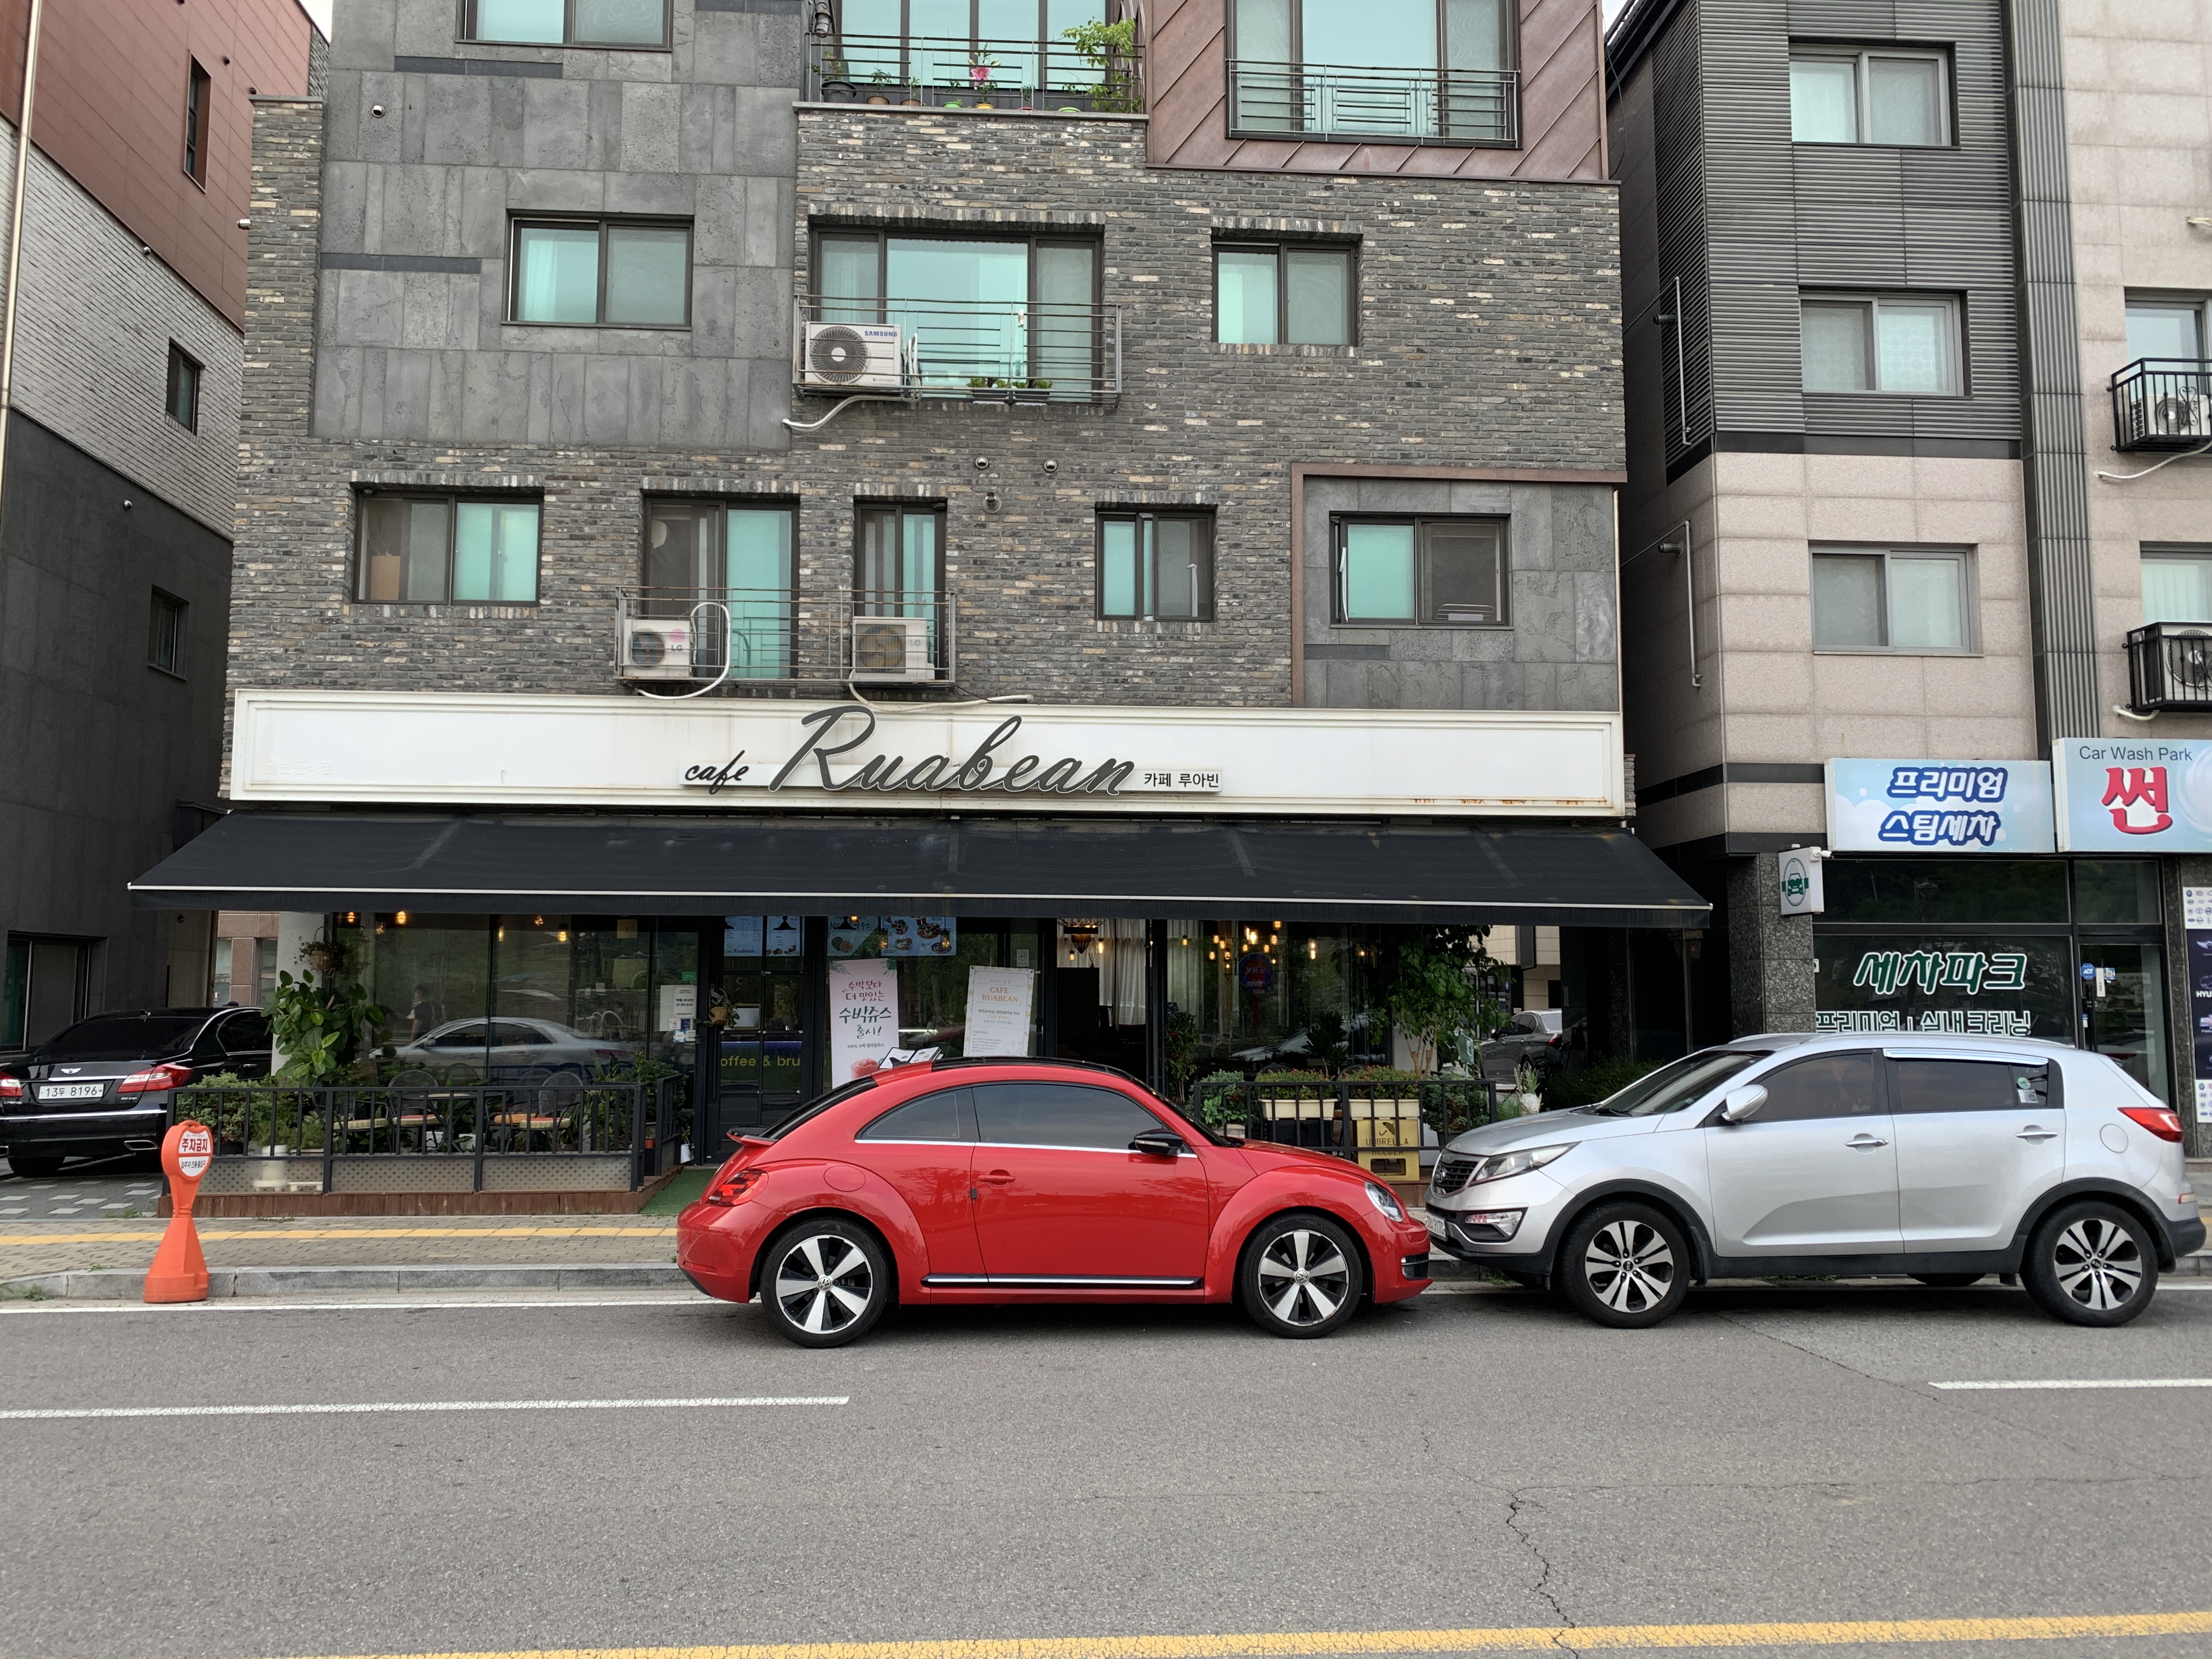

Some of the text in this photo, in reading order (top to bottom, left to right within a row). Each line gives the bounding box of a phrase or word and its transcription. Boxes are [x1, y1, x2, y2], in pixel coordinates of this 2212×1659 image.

[685, 705, 1135, 796] cafe Ruabean
[2079, 746, 2193, 760] Car Wash Park
[1144, 773, 1219, 788] 카페 루아빈
[1888, 769, 2006, 800] 프리미엄
[1880, 811, 2000, 844] 스팀세차
[1853, 950, 2027, 995] 세차파크
[848, 980, 882, 991] 수박보다
[859, 990, 885, 1002] 맛있는
[982, 994, 1018, 1003] RUABEAN
[839, 1006, 891, 1024] 수박쥬스
[1816, 1011, 1900, 1032] 프리미엄
[856, 1024, 882, 1039] 출시!
[720, 1056, 757, 1066] offee
[763, 1055, 771, 1066] &
[46, 1086, 97, 1097] 13두 8196
[182, 1138, 208, 1152] 주차금지
